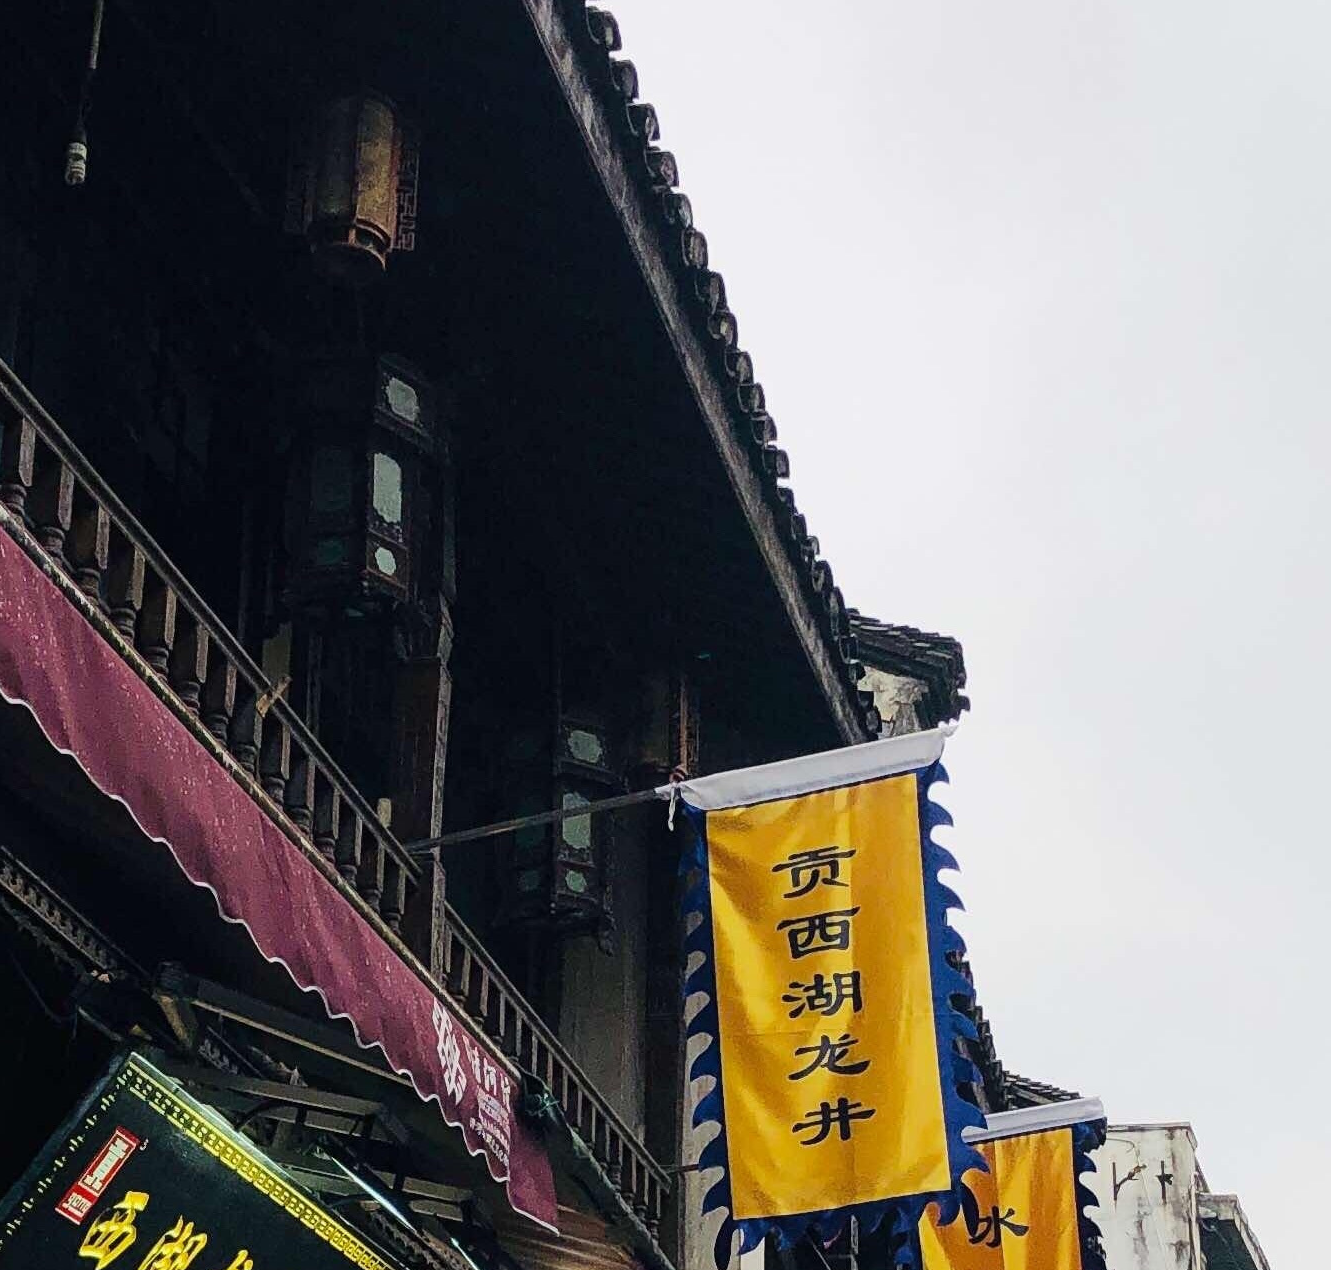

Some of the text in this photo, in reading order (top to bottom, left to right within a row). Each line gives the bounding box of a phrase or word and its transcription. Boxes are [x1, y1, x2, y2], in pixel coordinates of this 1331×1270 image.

[771, 846, 876, 1146] 贡西湖龙井
